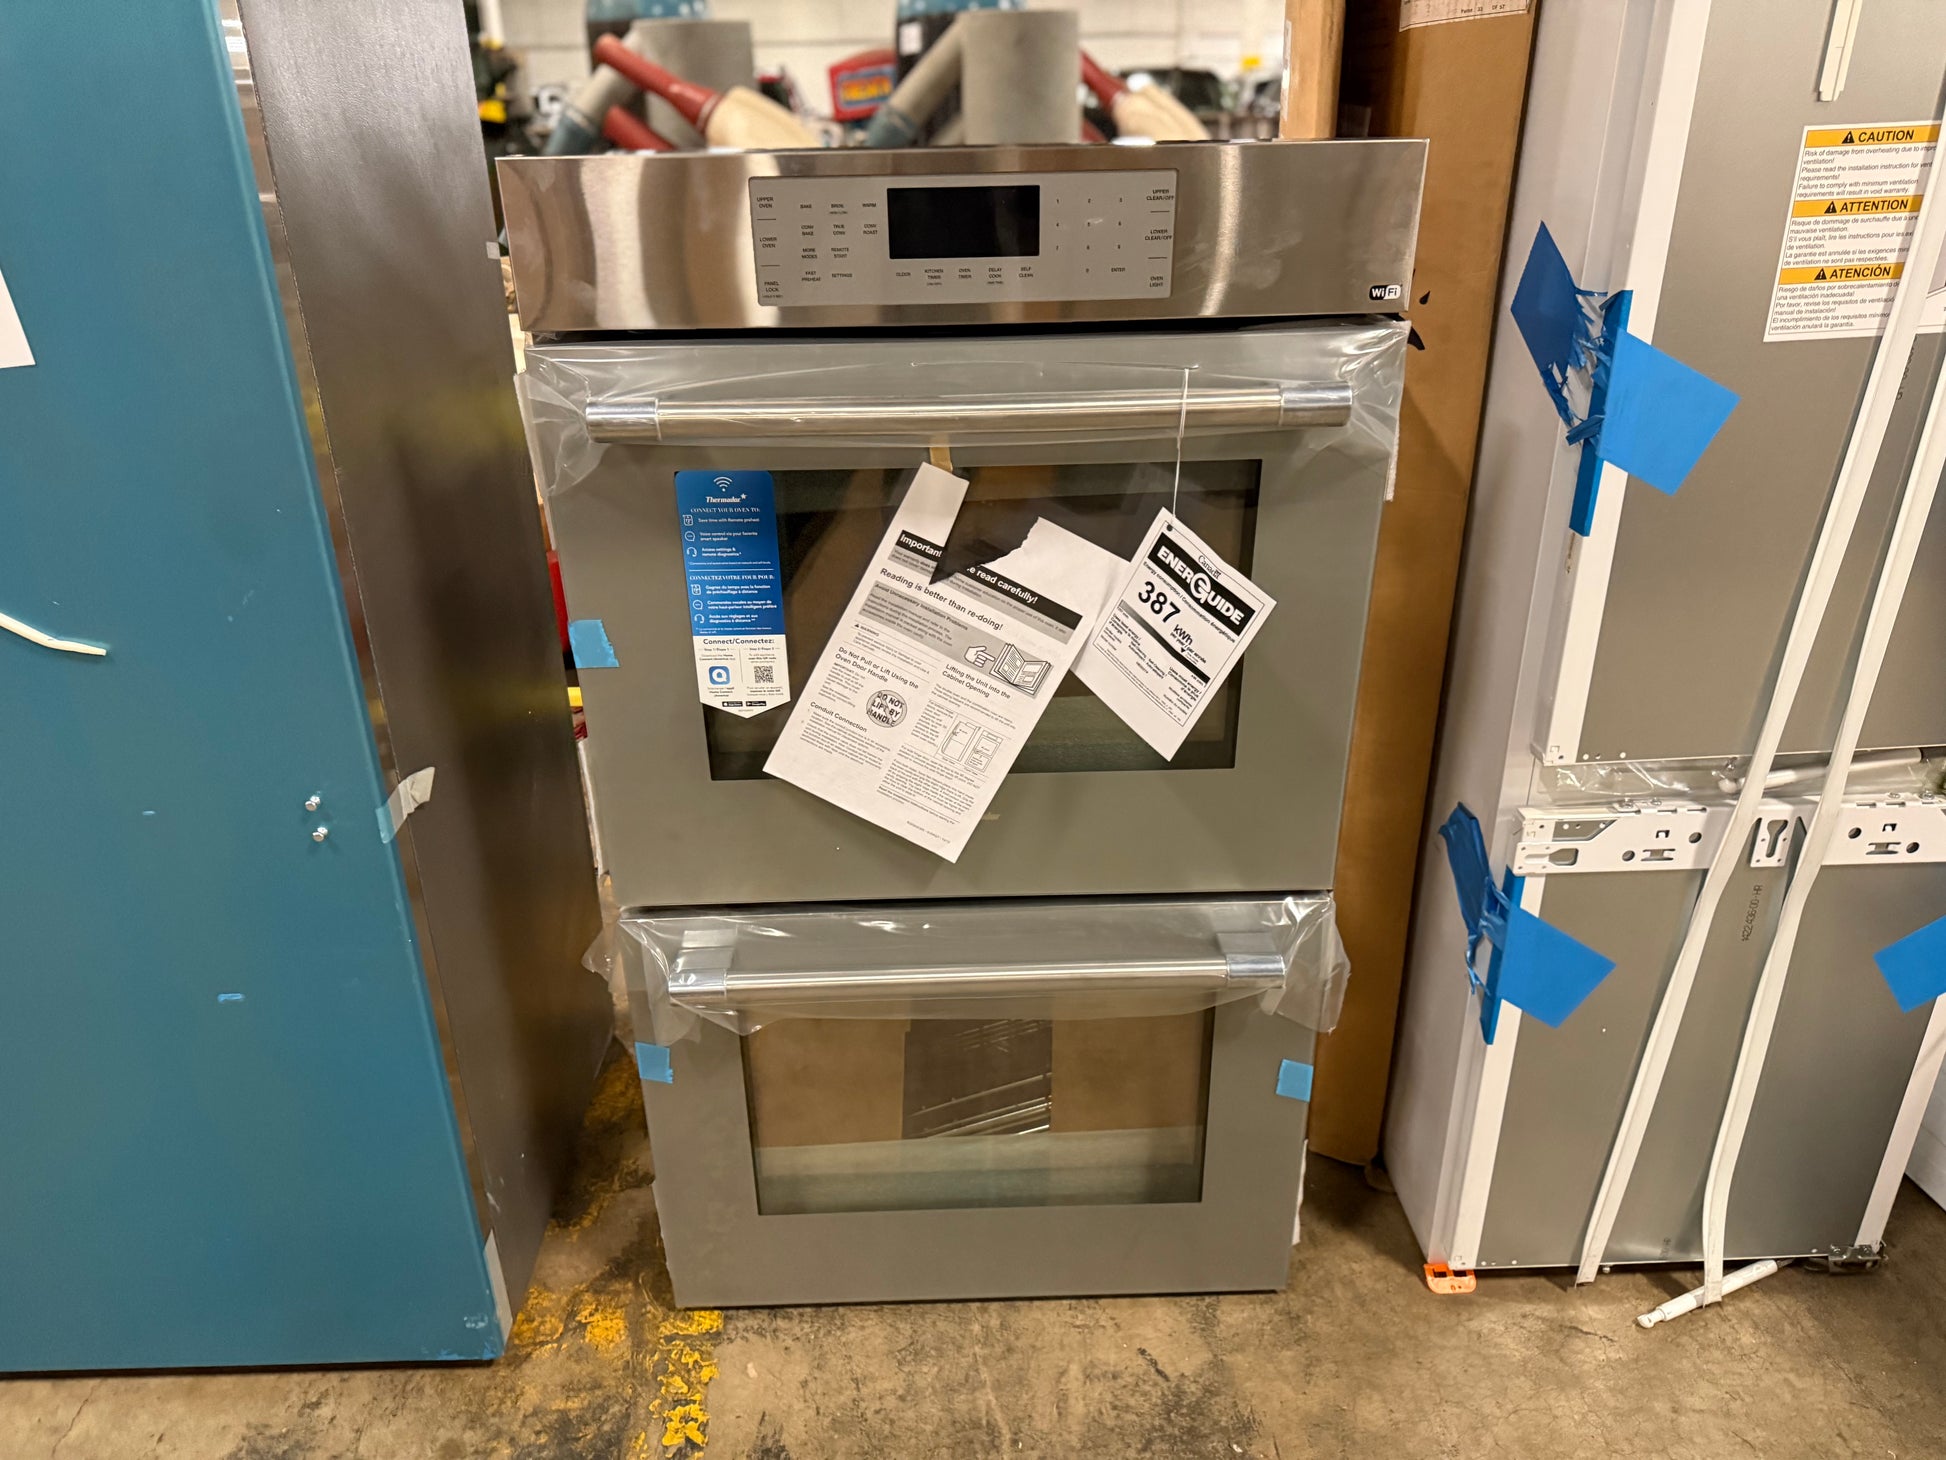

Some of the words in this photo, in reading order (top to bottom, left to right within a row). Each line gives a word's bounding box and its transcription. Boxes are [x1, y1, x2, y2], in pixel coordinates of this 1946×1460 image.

[1859, 130, 1914, 142] CAUTION
[1797, 190, 1834, 198] requirements
[1840, 200, 1909, 212] ATTENTION
[1830, 265, 1890, 279] ATENCIÓN
[1831, 298, 1858, 307] requisitos
[977, 570, 997, 584] read
[998, 580, 1038, 604] carefully!
[1143, 561, 1156, 576] Energy
[1157, 574, 1180, 596] consumption
[1181, 597, 1211, 623] Consommation
[1157, 545, 1244, 626] ENERGUIDE
[880, 568, 913, 588] Reading
[924, 586, 948, 602] better
[948, 600, 966, 613] than
[967, 609, 1003, 631] re-doing!
[1138, 581, 1181, 623] 387
[1174, 624, 1193, 645] kWh
[1176, 638, 1186, 646] year
[1194, 652, 1206, 663] année
[835, 653, 851, 664] Oven
[852, 660, 867, 672] Door
[867, 668, 888, 682] Handle
[849, 651, 860, 660] Not
[860, 656, 872, 666] Pull
[880, 666, 891, 675] Lift
[891, 672, 908, 685] Using
[909, 680, 919, 689] the
[946, 664, 964, 678] Lifting
[966, 673, 975, 681] the
[976, 678, 988, 688] Unit
[989, 685, 1000, 694] into
[942, 671, 965, 685] Cabinet
[965, 682, 990, 698] Opening
[872, 701, 888, 712] LIFT
[889, 709, 900, 717] BY
[888, 697, 904, 709] NOT
[810, 701, 834, 716] Conduit
[834, 713, 867, 732] Connection
[866, 709, 896, 727] HANDLE
